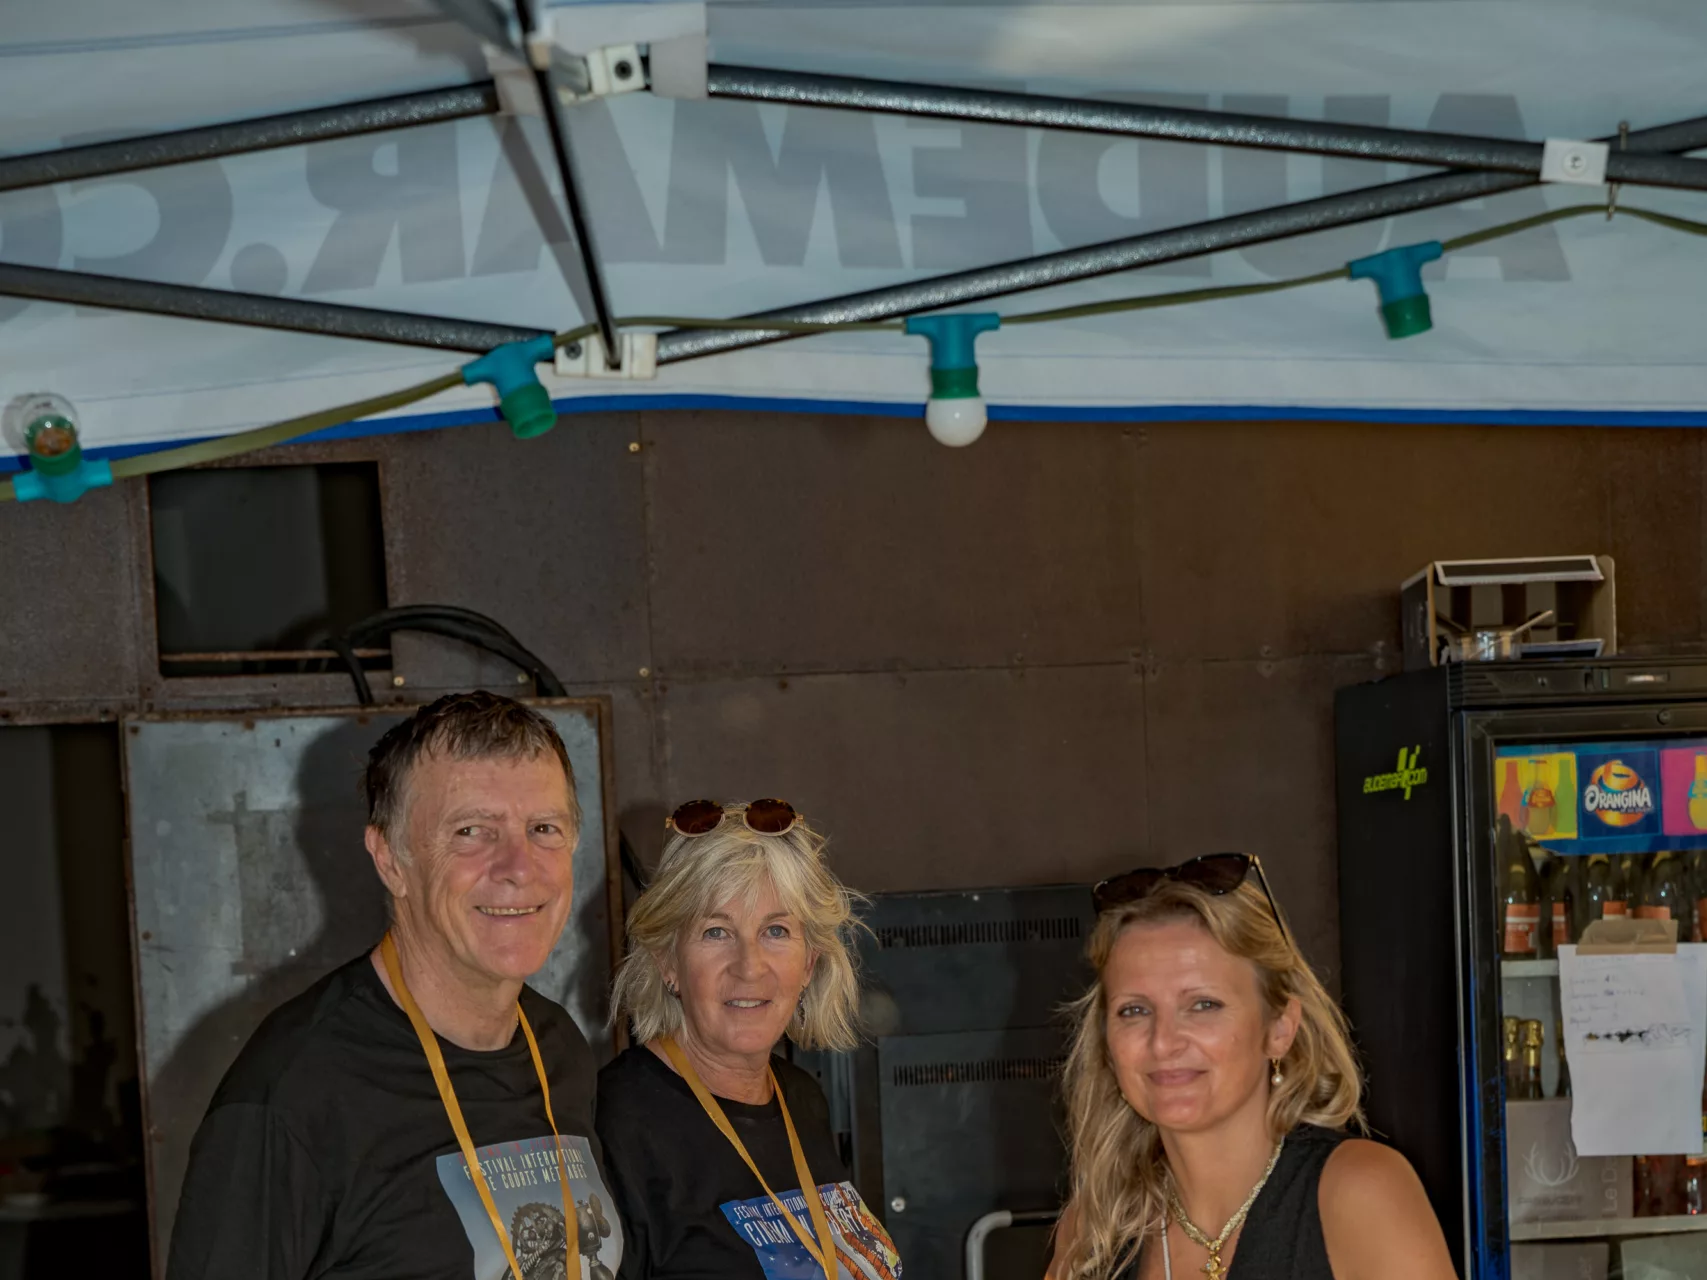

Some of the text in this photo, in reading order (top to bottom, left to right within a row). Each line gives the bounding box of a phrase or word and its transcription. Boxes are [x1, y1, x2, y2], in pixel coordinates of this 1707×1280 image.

[1584, 784, 1652, 812] ORANGINA
[463, 1156, 517, 1180] FSTIVAL
[542, 1163, 587, 1184] MÉTAGES
